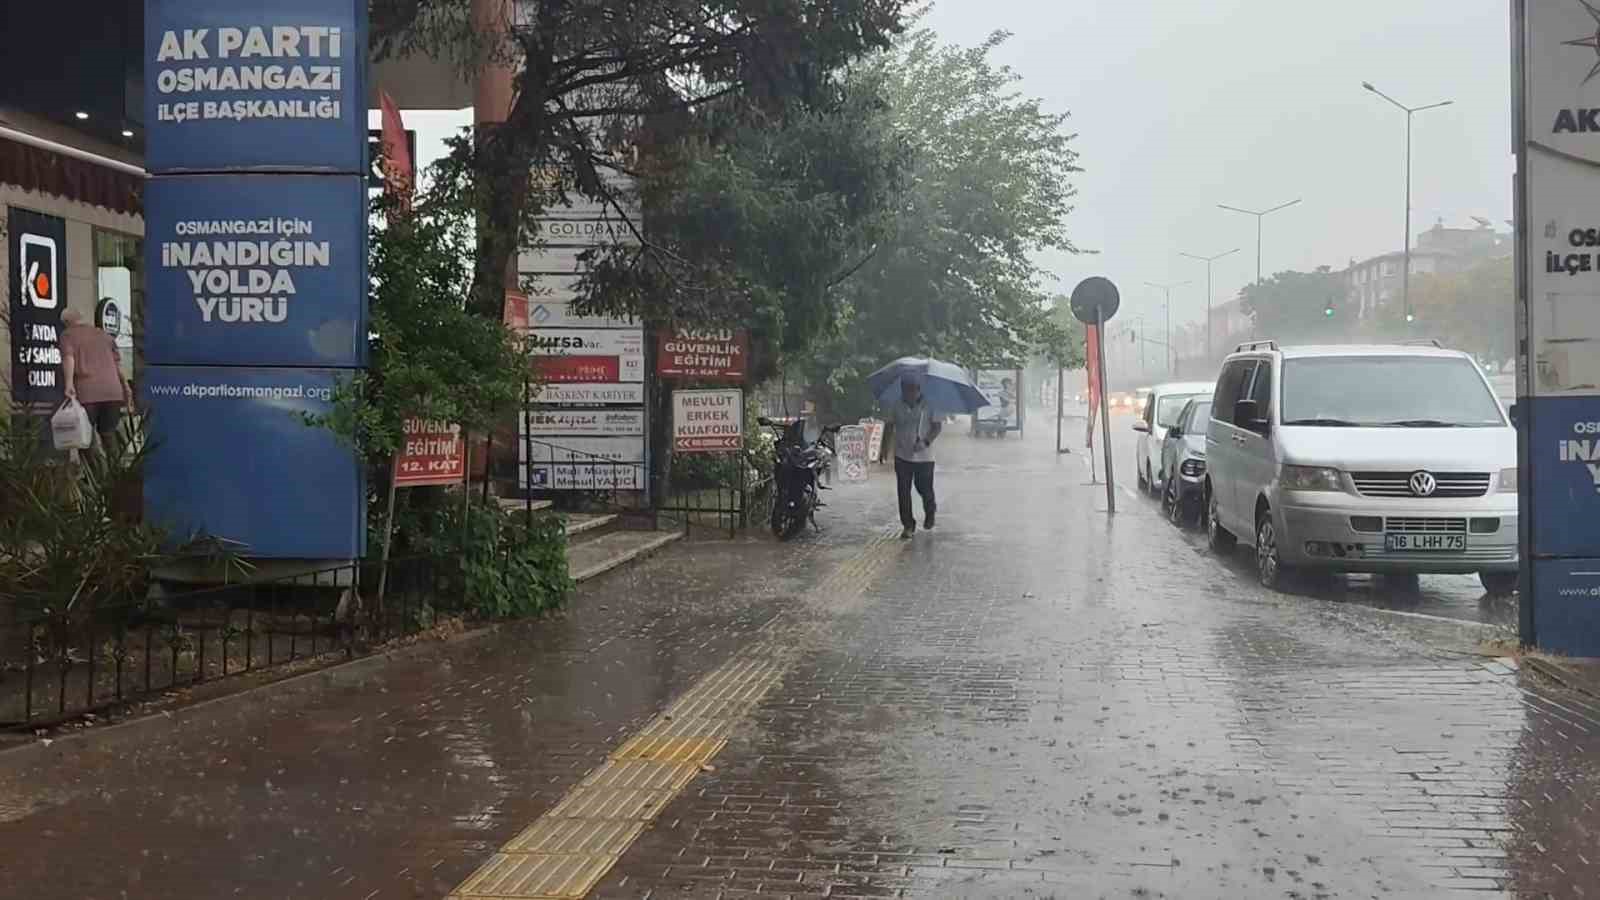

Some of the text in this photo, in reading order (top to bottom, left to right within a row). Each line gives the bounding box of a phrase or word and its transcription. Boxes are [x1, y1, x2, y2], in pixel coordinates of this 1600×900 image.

[157, 26, 341, 62] AK PARTİ
[157, 66, 341, 93] OSMANGAZİ
[158, 96, 340, 123] İLÇE BAŞKANLIĞI
[1552, 108, 1600, 133] AK
[175, 217, 313, 237] OSMANGAZİ İÇİN
[162, 237, 329, 267] İNANDIĞIN
[1546, 251, 1592, 275] İLÇE
[187, 269, 296, 294] YOLDA
[196, 297, 287, 322] YÜRÜ
[33, 324, 57, 341] AYDA
[33, 345, 62, 364] SAHİB
[664, 341, 741, 355] GÜVENLİK
[674, 353, 731, 368] EĞİTİMİ
[28, 370, 56, 388] OLUN
[150, 383, 331, 400] www.akpartiosmangazi.org
[687, 410, 729, 421] ERKEK
[402, 416, 460, 434] GÜVENL
[401, 460, 460, 472] 12. KAT
[1394, 536, 1463, 548] 16 LHH 75
[1558, 585, 1600, 596] www.a
